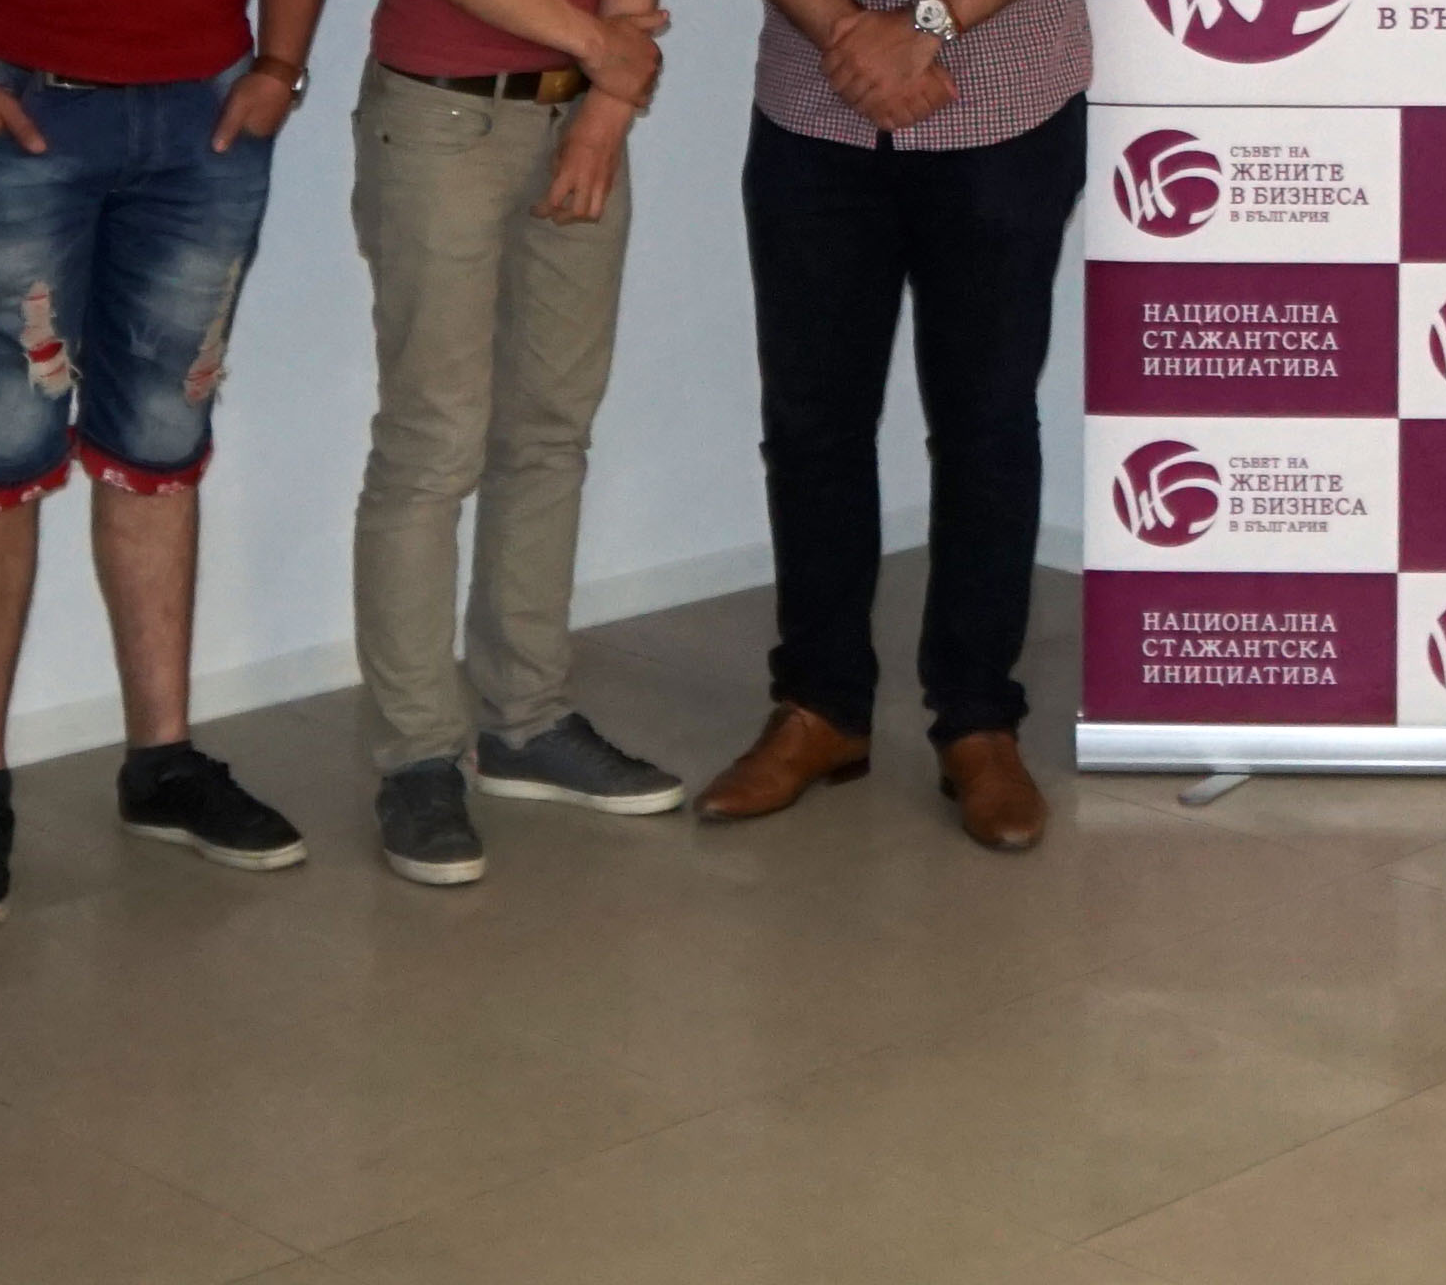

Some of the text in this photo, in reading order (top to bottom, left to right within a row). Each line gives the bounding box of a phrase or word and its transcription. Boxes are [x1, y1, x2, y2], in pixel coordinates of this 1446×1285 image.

[1378, 7, 1397, 29] В
[1230, 146, 1310, 158] СЪВЕТ НА
[1231, 163, 1343, 181] ЖЕНИТЕ
[1230, 187, 1369, 205] В БИЗНЕСА
[1230, 211, 1329, 222] В БЪЛГАРИЯ
[1144, 304, 1338, 325] НАЦИОНАЛНА
[1143, 331, 1338, 350] СТАЖАНТСКА
[1144, 357, 1338, 378] ИНИЦИАТИВА
[1229, 457, 1308, 469] СЪВЕТ НА
[1230, 474, 1343, 492] ЖЕНИТЕ
[1230, 497, 1367, 515] В БИЗНЕСА
[1230, 521, 1327, 533] В БЪЛГАРИЯ
[1143, 612, 1337, 633] НАЦИОНАЛНА
[1142, 639, 1337, 658] СТАЖАНТСКА
[1143, 665, 1337, 686] ИНИЦИАТИВА
